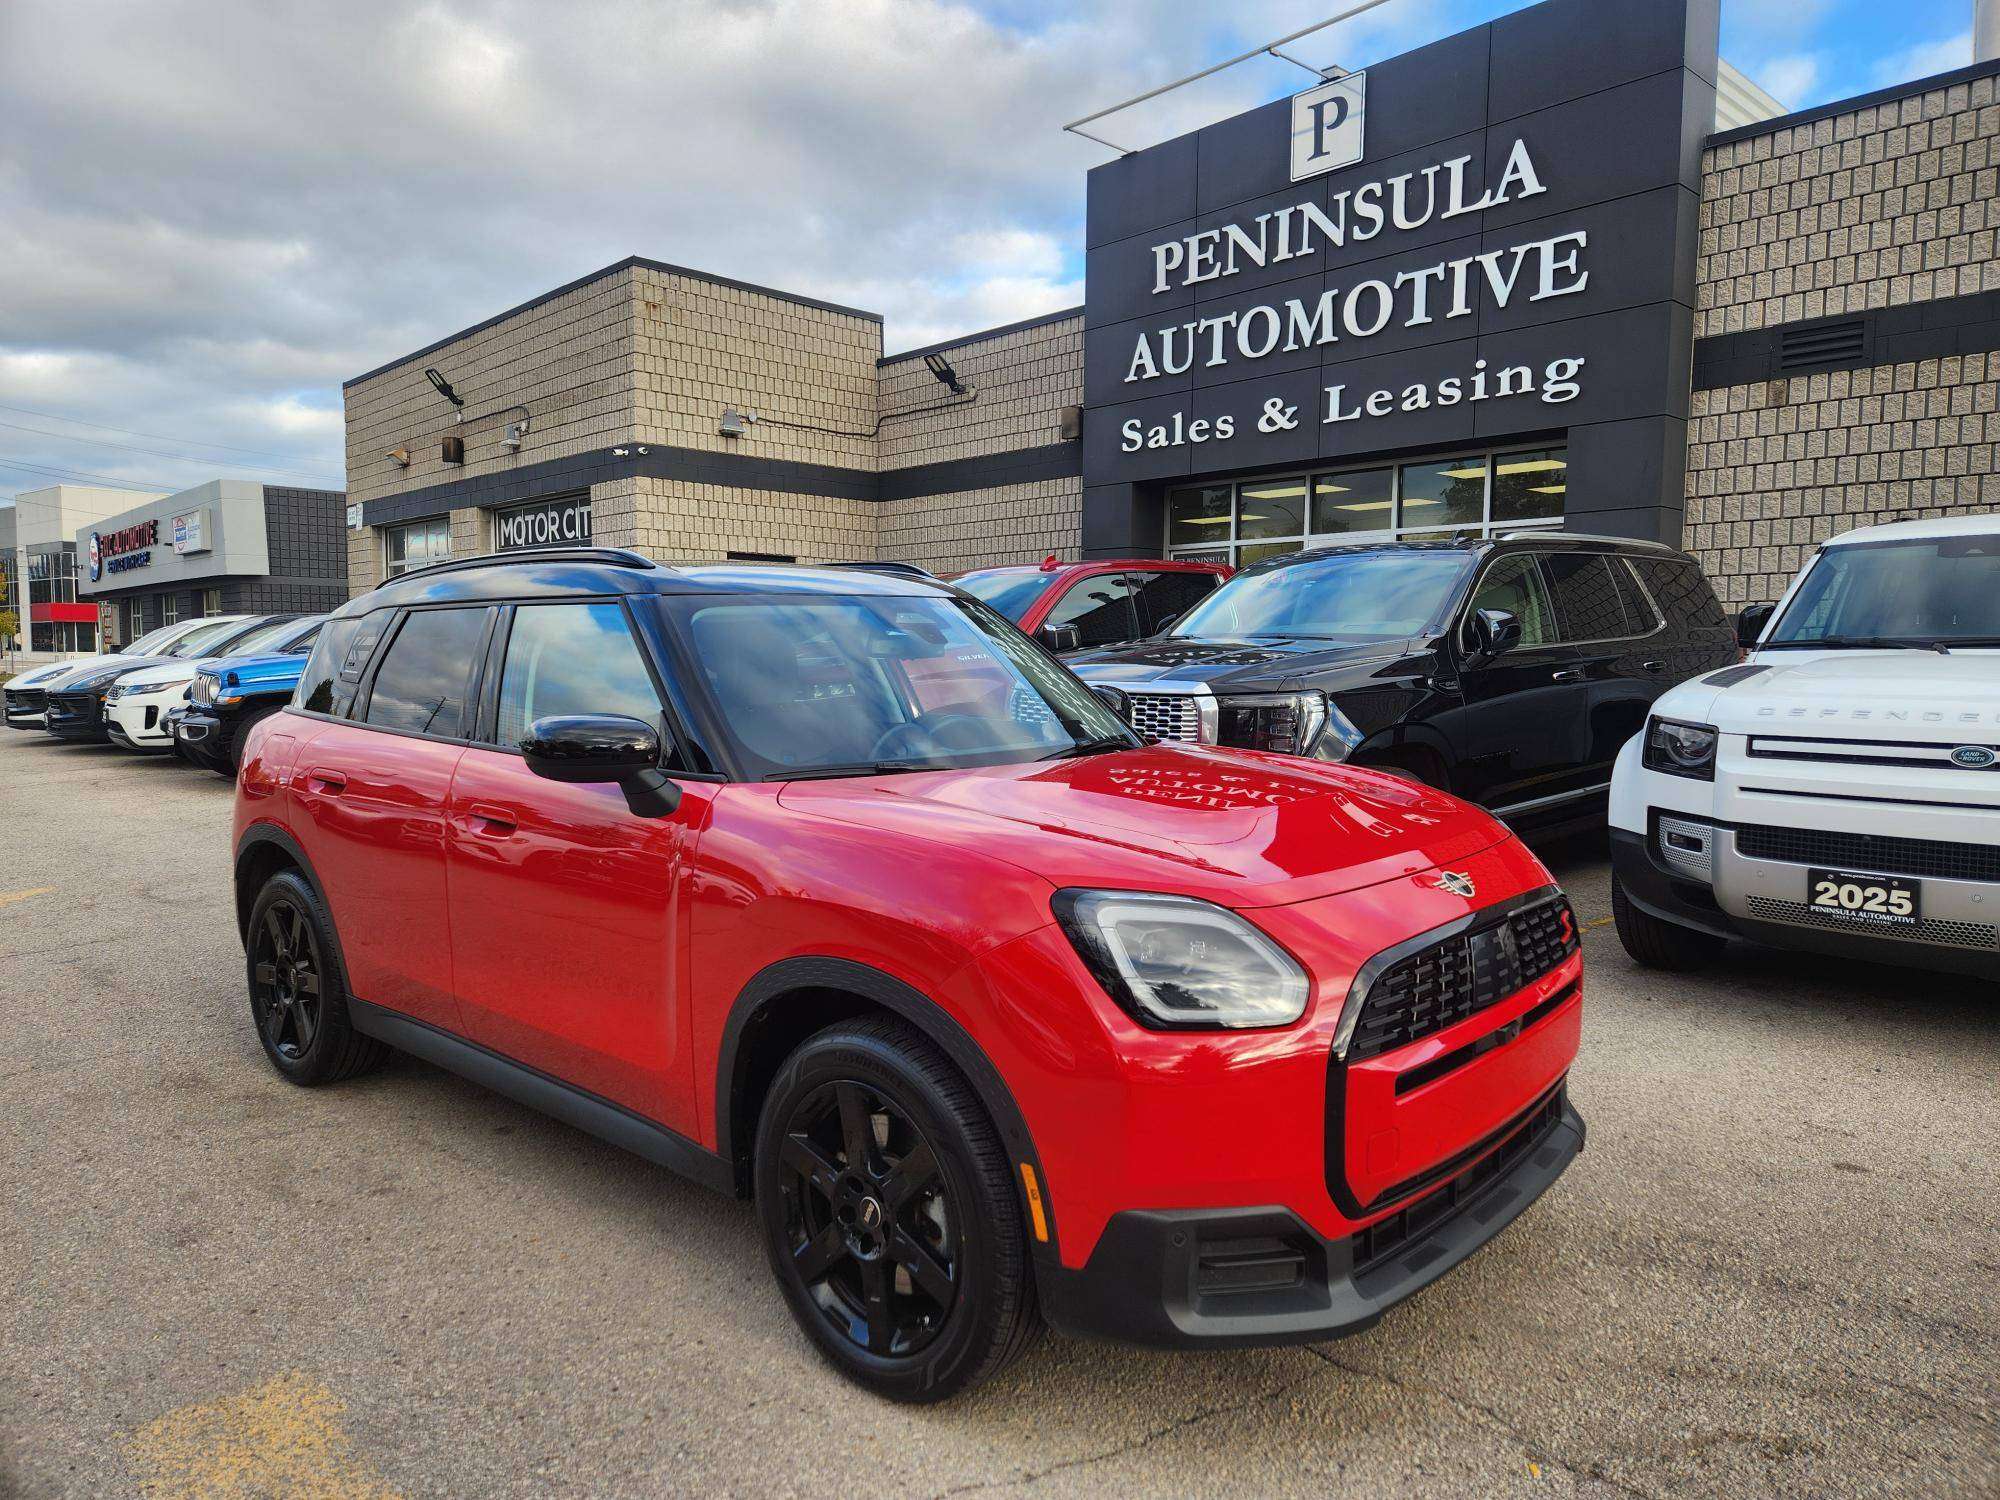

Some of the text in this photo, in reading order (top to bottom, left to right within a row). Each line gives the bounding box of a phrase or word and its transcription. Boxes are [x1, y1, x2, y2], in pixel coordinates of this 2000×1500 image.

[1306, 96, 1348, 162] P
[1151, 138, 1547, 294] PENINSULA
[1124, 230, 1589, 383] AUTOMOTIVE
[1121, 357, 1585, 453] Sales & Leasing
[501, 510, 560, 547] MOTOR
[1810, 905, 1916, 924] PENINSULA AUTOMOTIVE
[1814, 881, 1913, 915] 2025
